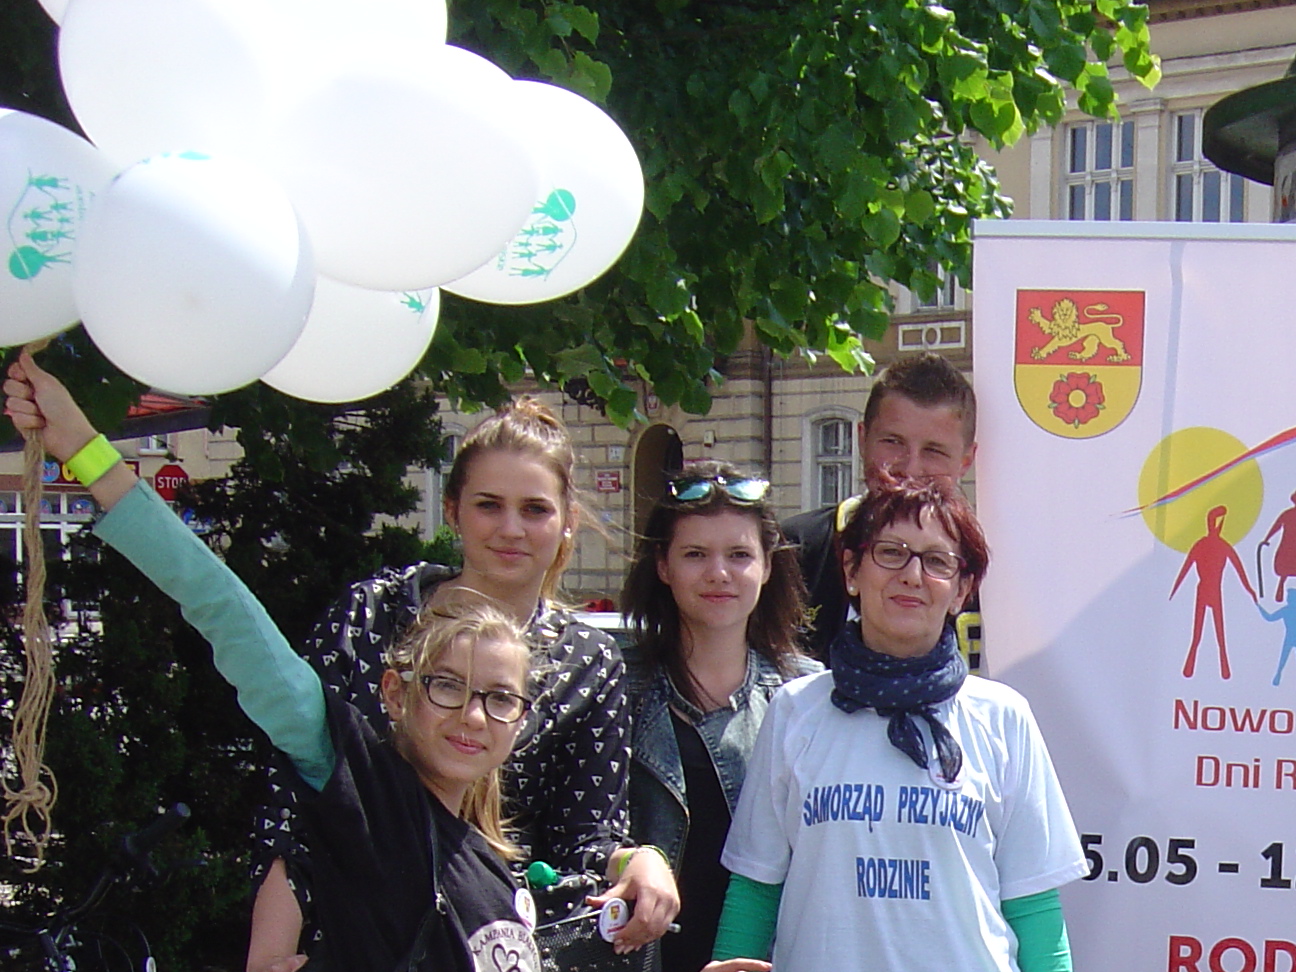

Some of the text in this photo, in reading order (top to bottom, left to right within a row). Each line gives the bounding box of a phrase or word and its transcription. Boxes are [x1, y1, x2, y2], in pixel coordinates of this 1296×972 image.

[1195, 755, 1261, 789] Dni
[897, 785, 986, 838] PRZYJAZNY
[855, 856, 931, 900] RODZINIE
[1080, 833, 1199, 886] 5.05
